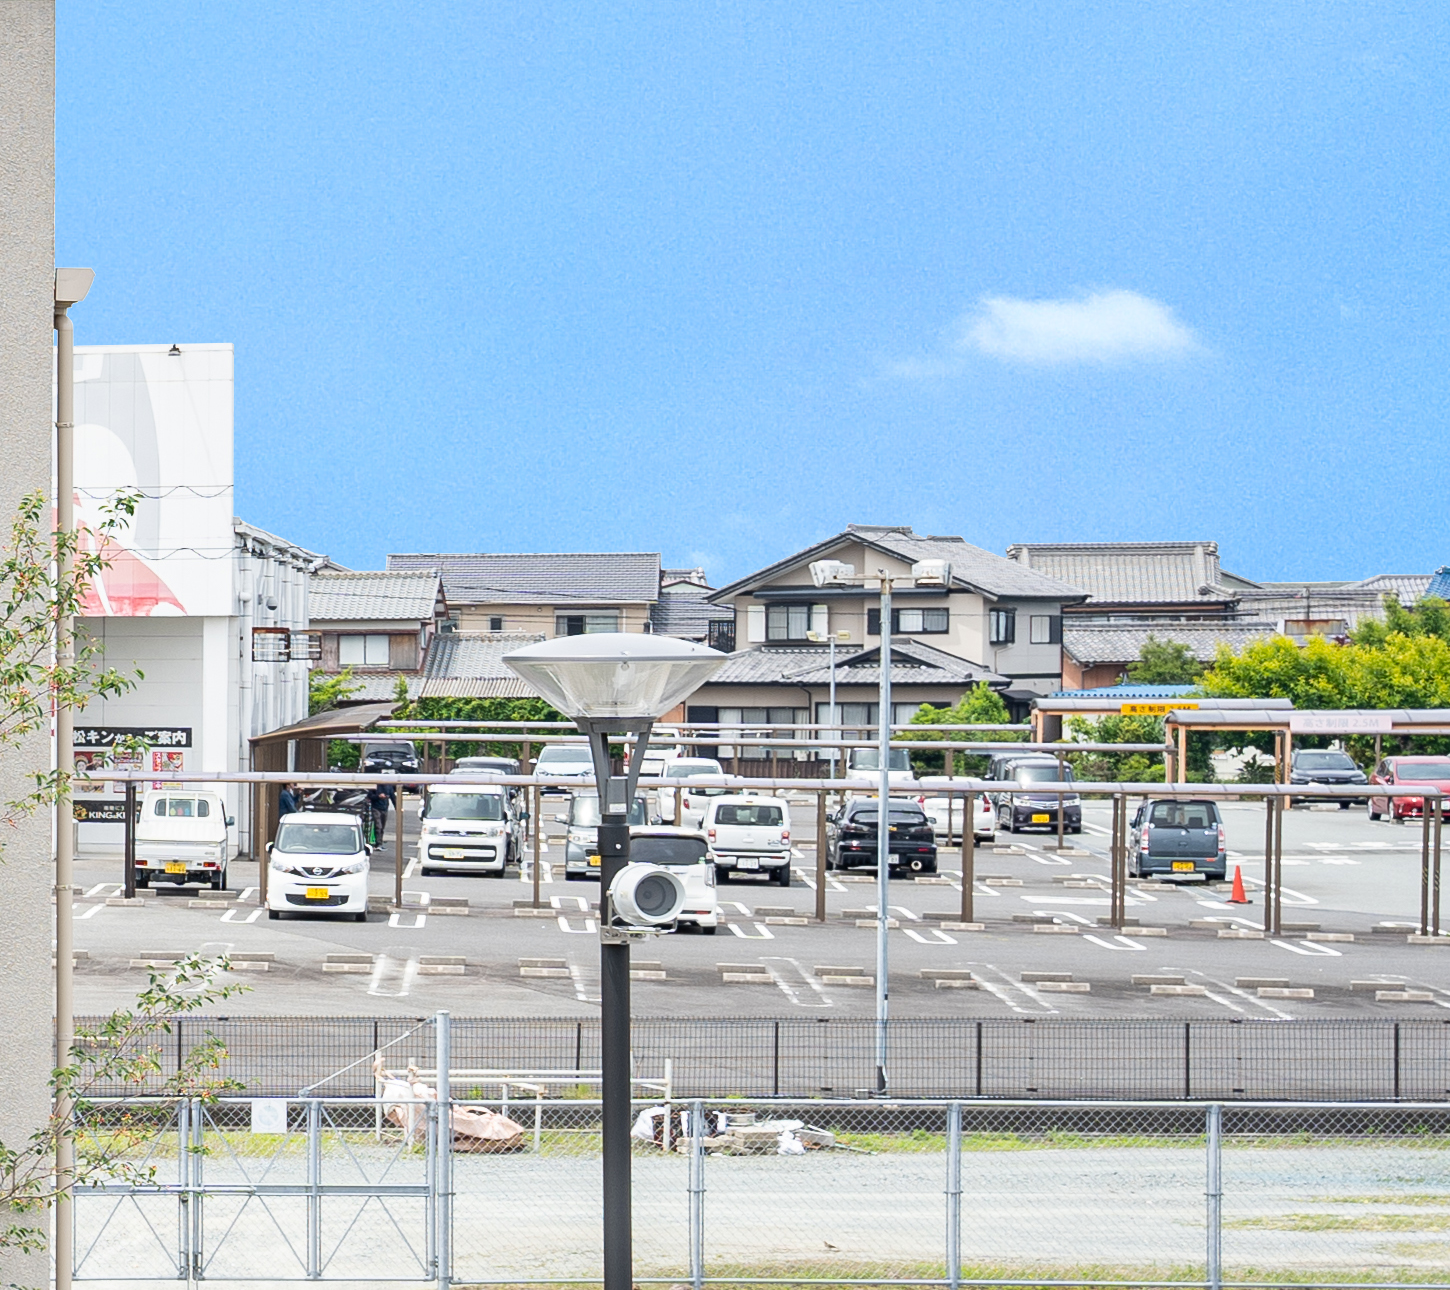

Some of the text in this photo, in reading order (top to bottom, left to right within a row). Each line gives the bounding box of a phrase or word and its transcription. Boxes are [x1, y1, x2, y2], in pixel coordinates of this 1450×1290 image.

[1130, 705, 1166, 713] 高さ制限
[1303, 718, 1380, 728] 高さ制限 2.5M
